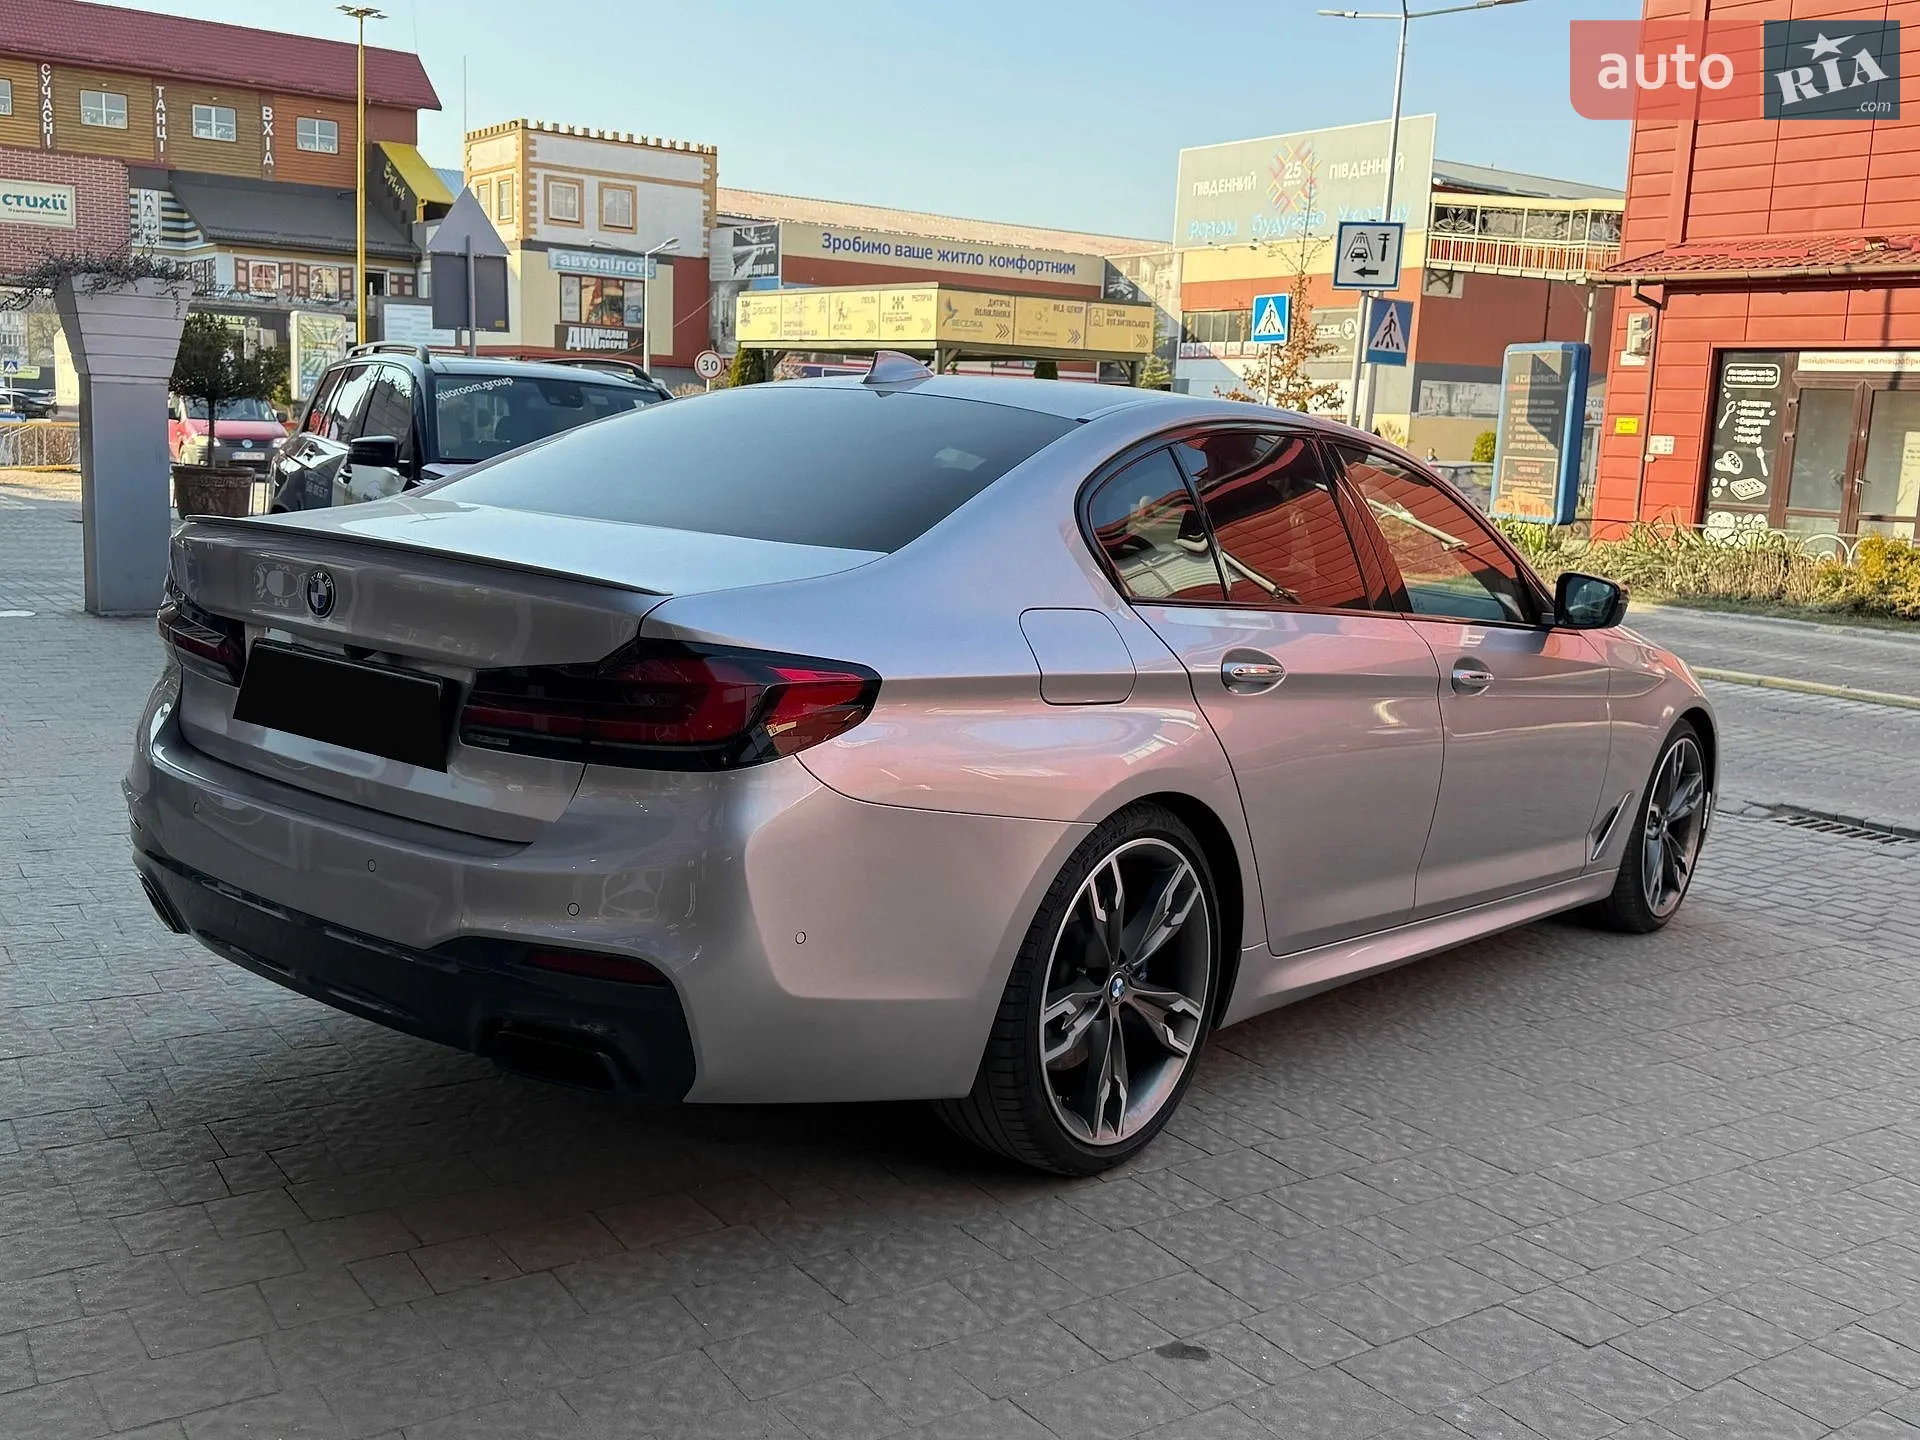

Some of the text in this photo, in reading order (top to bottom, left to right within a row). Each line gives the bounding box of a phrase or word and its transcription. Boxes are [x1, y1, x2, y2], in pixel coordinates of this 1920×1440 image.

[40, 63, 53, 149] СУЧАСНІ
[155, 86, 167, 152] ТАНЦІ
[1284, 161, 1301, 180] 25
[1192, 171, 1257, 197] ПІВДЕННИЙ
[2, 193, 67, 211] стихії
[822, 232, 1076, 275] Зробимо ваше житло комфортним
[565, 326, 600, 351] ДІМ
[702, 360, 718, 371] 30
